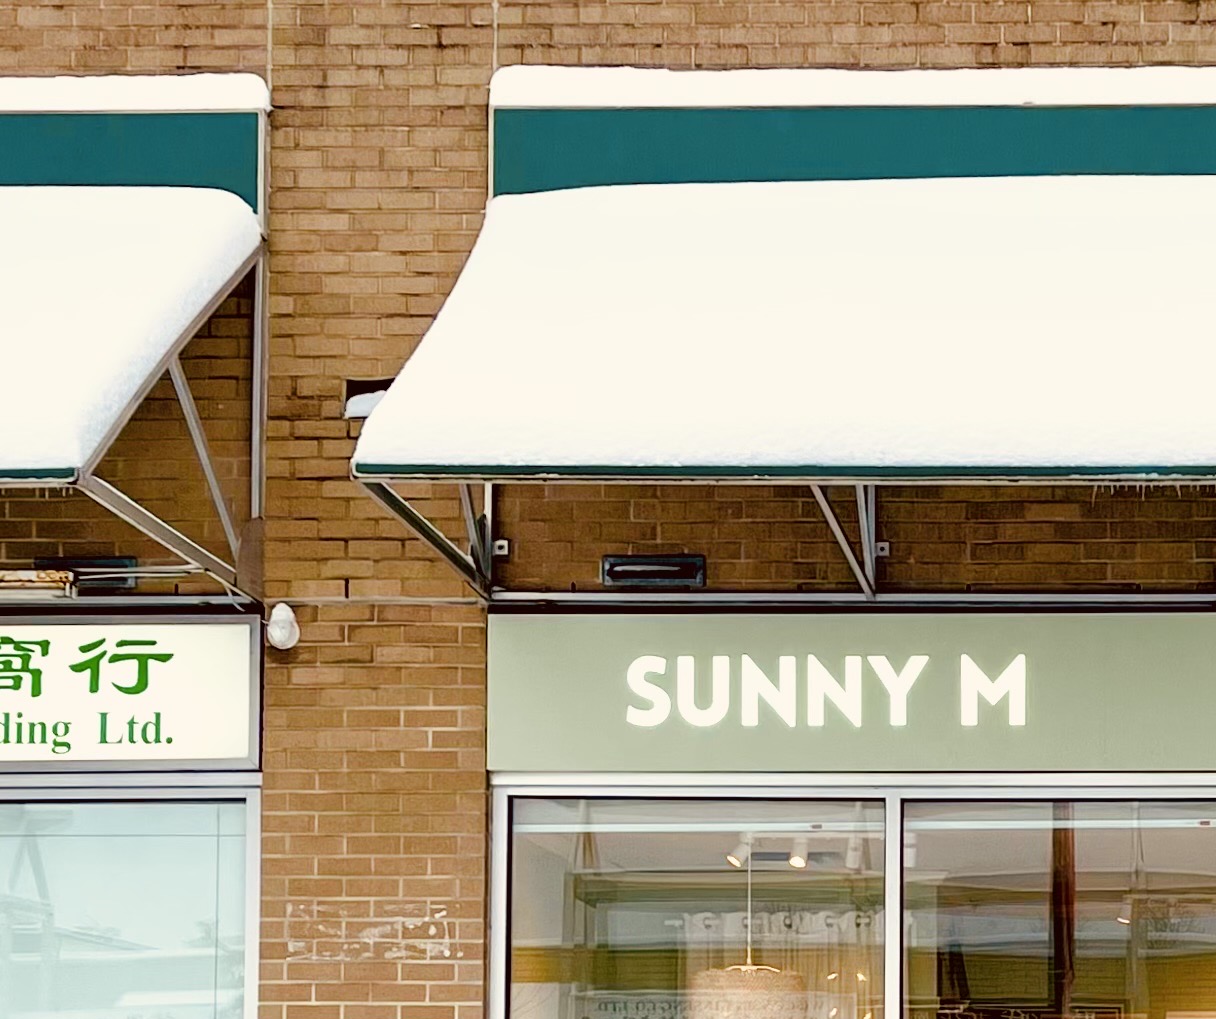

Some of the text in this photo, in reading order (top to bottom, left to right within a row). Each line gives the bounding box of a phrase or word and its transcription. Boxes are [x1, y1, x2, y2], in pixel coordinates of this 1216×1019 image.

[626, 653, 1027, 728] SUNNY M
[97, 711, 174, 745] Ltd.
